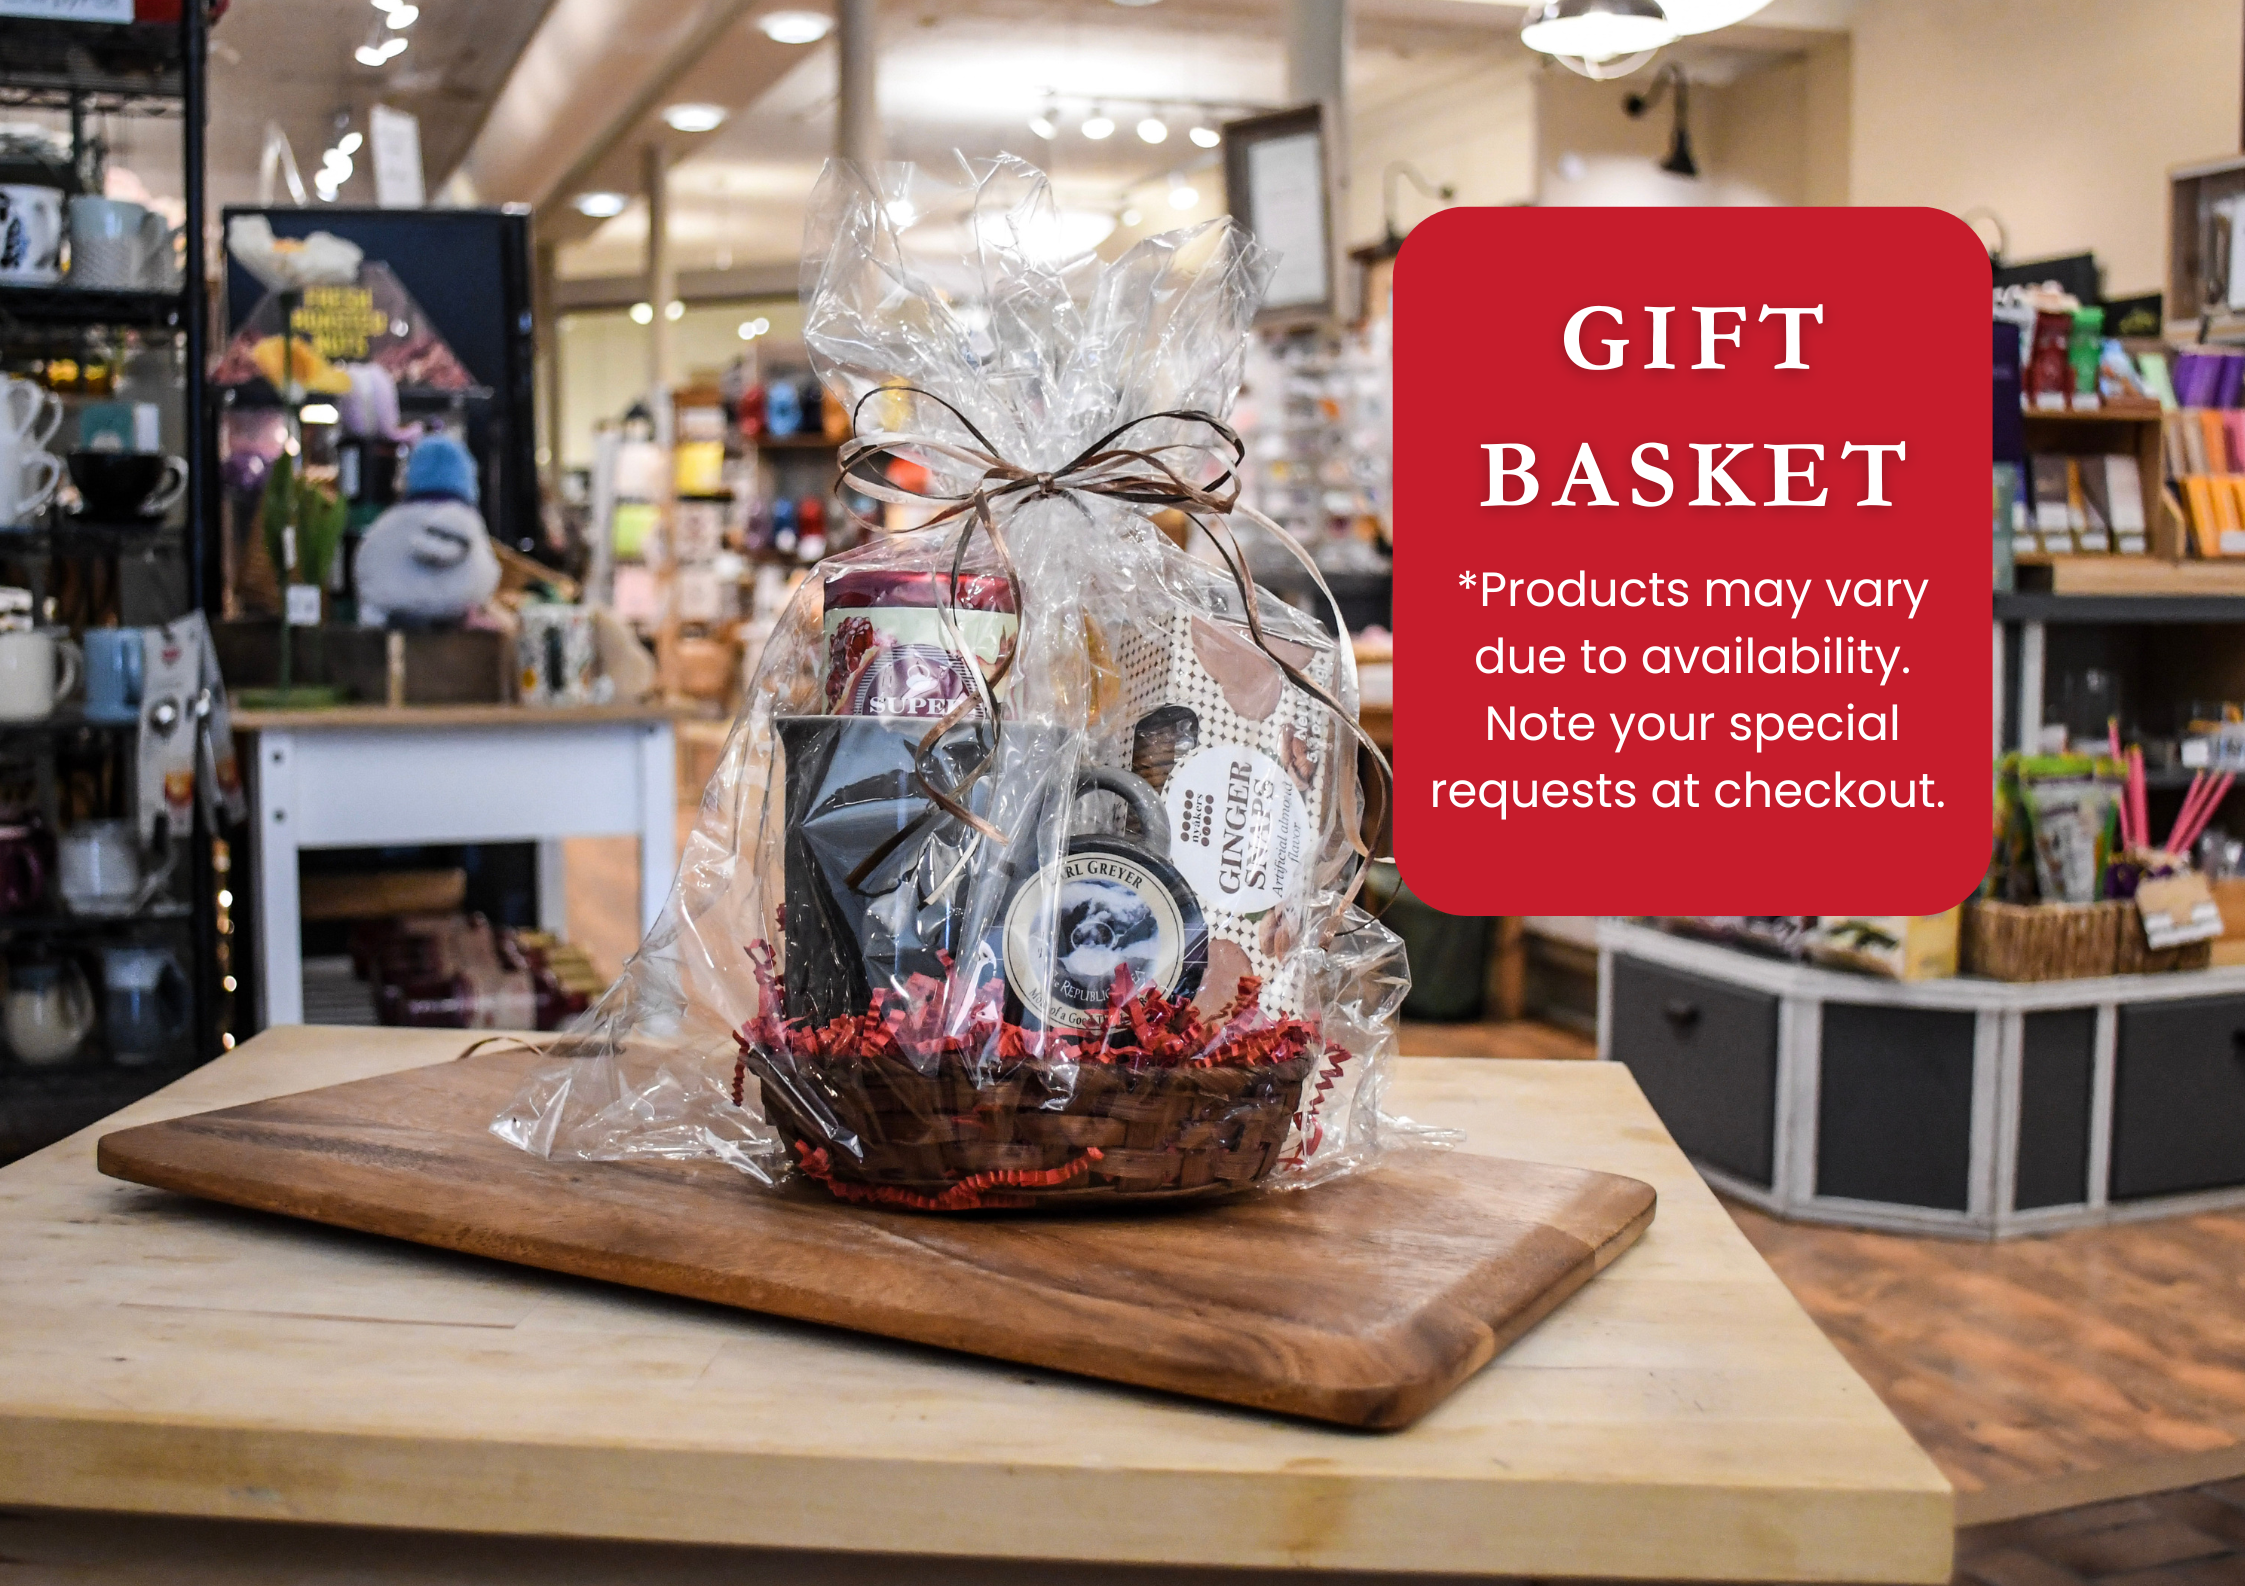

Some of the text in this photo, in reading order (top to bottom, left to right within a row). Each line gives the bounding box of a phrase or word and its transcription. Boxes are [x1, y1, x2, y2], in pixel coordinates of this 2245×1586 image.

[1192, 793, 1204, 843] nyåkers
[1218, 761, 1253, 895] GINGER
[1244, 778, 1275, 891] SNAPS
[1272, 781, 1294, 898] Artificial almond
[1287, 821, 1302, 864] flavor
[1087, 860, 1143, 890] GREYER
[1050, 1006, 1063, 1017] of
[1068, 1012, 1091, 1026] Goo
